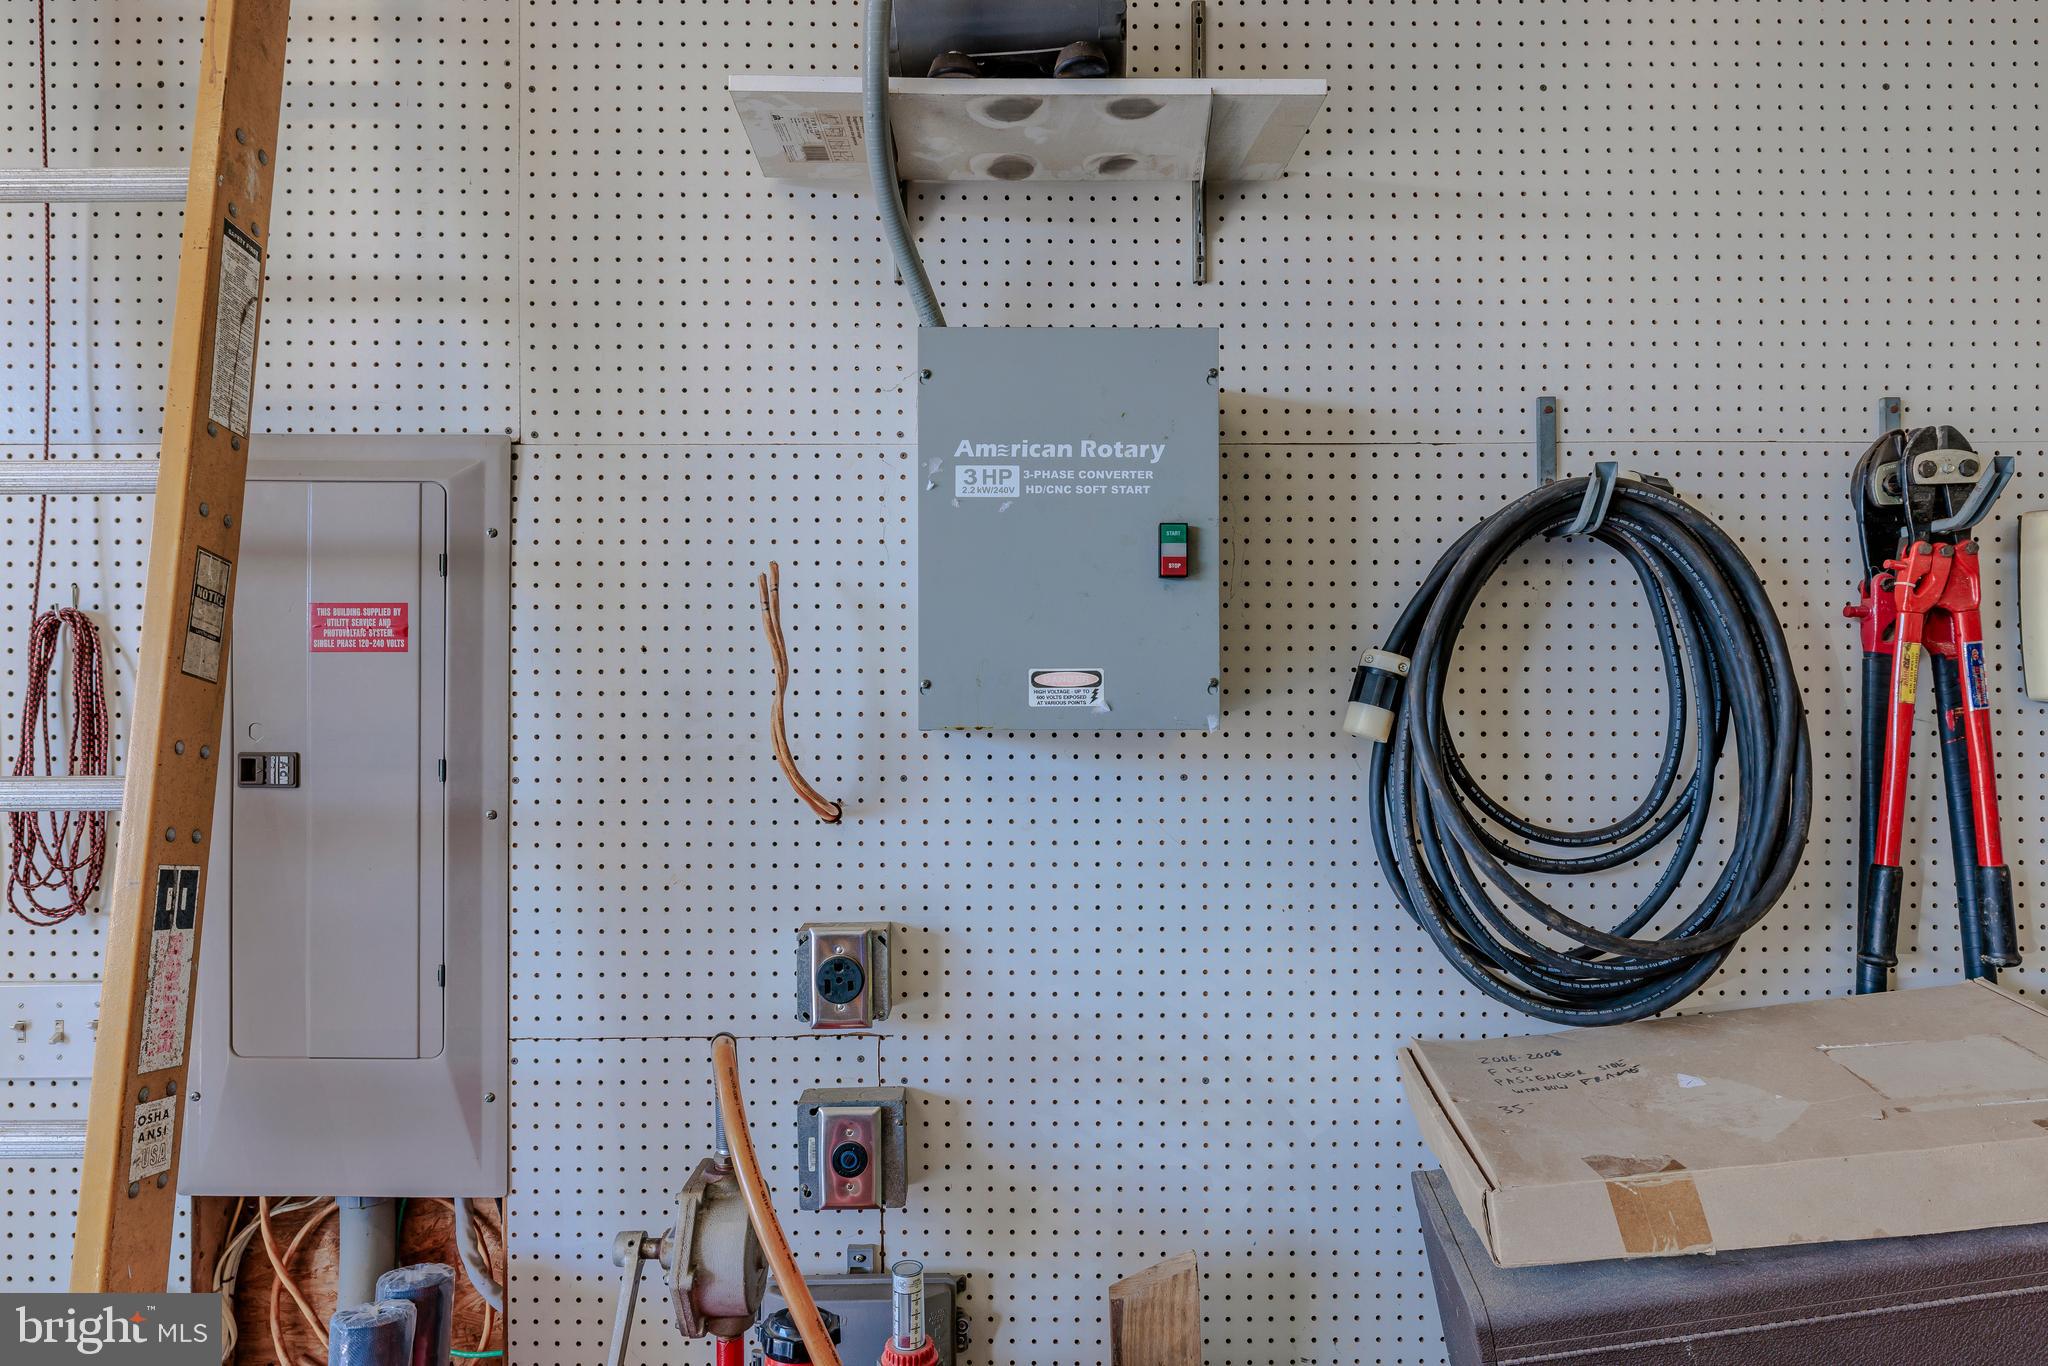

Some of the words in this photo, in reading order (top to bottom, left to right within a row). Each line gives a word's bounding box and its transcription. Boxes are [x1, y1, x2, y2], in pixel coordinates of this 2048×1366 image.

[954, 439, 1073, 458] American
[1080, 439, 1166, 464] Rotary
[963, 468, 977, 486] 3
[982, 468, 1013, 486] HP
[1023, 470, 1075, 480] 3-PHASE
[1078, 470, 1154, 480] CONVERTER
[962, 486, 976, 494] 2.2
[1025, 485, 1072, 495] HD/CNC
[1075, 485, 1107, 494] SOFT
[1111, 485, 1151, 494] START
[197, 586, 224, 606] NOTICE
[317, 608, 331, 616] THIS
[333, 608, 360, 616] BUILDING
[363, 608, 391, 616] SUPPLIED
[393, 608, 401, 616] BY
[326, 619, 349, 627] UTILITY
[351, 619, 376, 627] SERVICE
[378, 619, 392, 627] AND
[323, 629, 366, 637] PHOTOVOLTAIC
[313, 640, 335, 648] SINGLE
[336, 640, 357, 648] PHASE
[358, 640, 384, 648] 120-240
[386, 640, 405, 648] VOLTS
[1598, 1059, 1627, 1071] SIDE
[1487, 1068, 1497, 1076] F
[1506, 1066, 1533, 1074] 150
[1579, 1064, 1641, 1086] FRAME
[138, 1109, 170, 1127] OSHA
[138, 1126, 167, 1143] ANSI
[141, 1143, 167, 1169] USA
